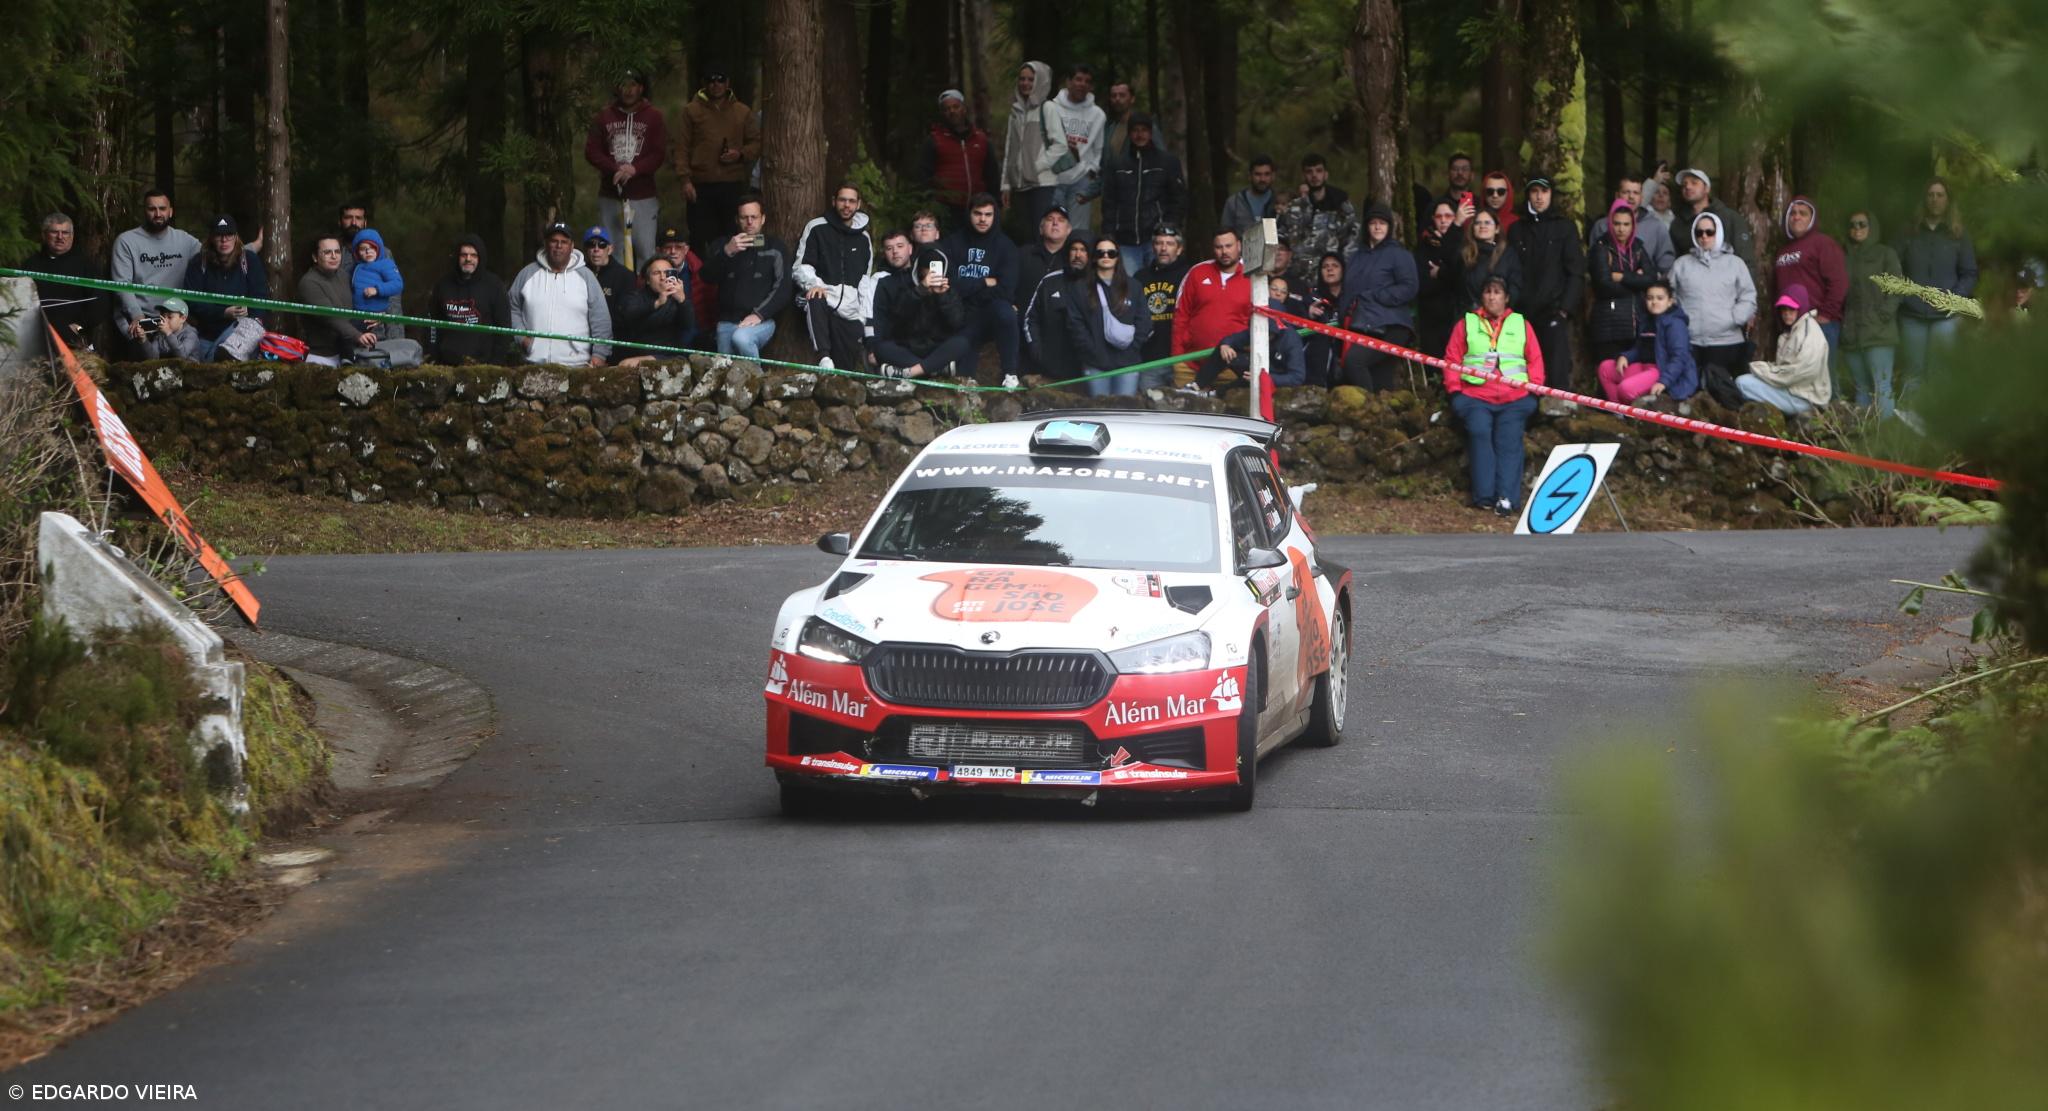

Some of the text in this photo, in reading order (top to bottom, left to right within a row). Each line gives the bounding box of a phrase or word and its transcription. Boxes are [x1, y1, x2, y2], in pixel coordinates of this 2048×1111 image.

[1143, 282, 1175, 295] ASTRA
[915, 465, 1209, 488] WWW.INAZORES.NET
[786, 678, 868, 718] Além Mar
[1105, 694, 1207, 727] Além Mar
[810, 757, 860, 771] transinsular
[881, 768, 929, 778] MICHELIN
[956, 767, 1014, 778] 4849 MJC
[1044, 774, 1092, 782] MICHELIN
[1129, 768, 1188, 779] transinsular
